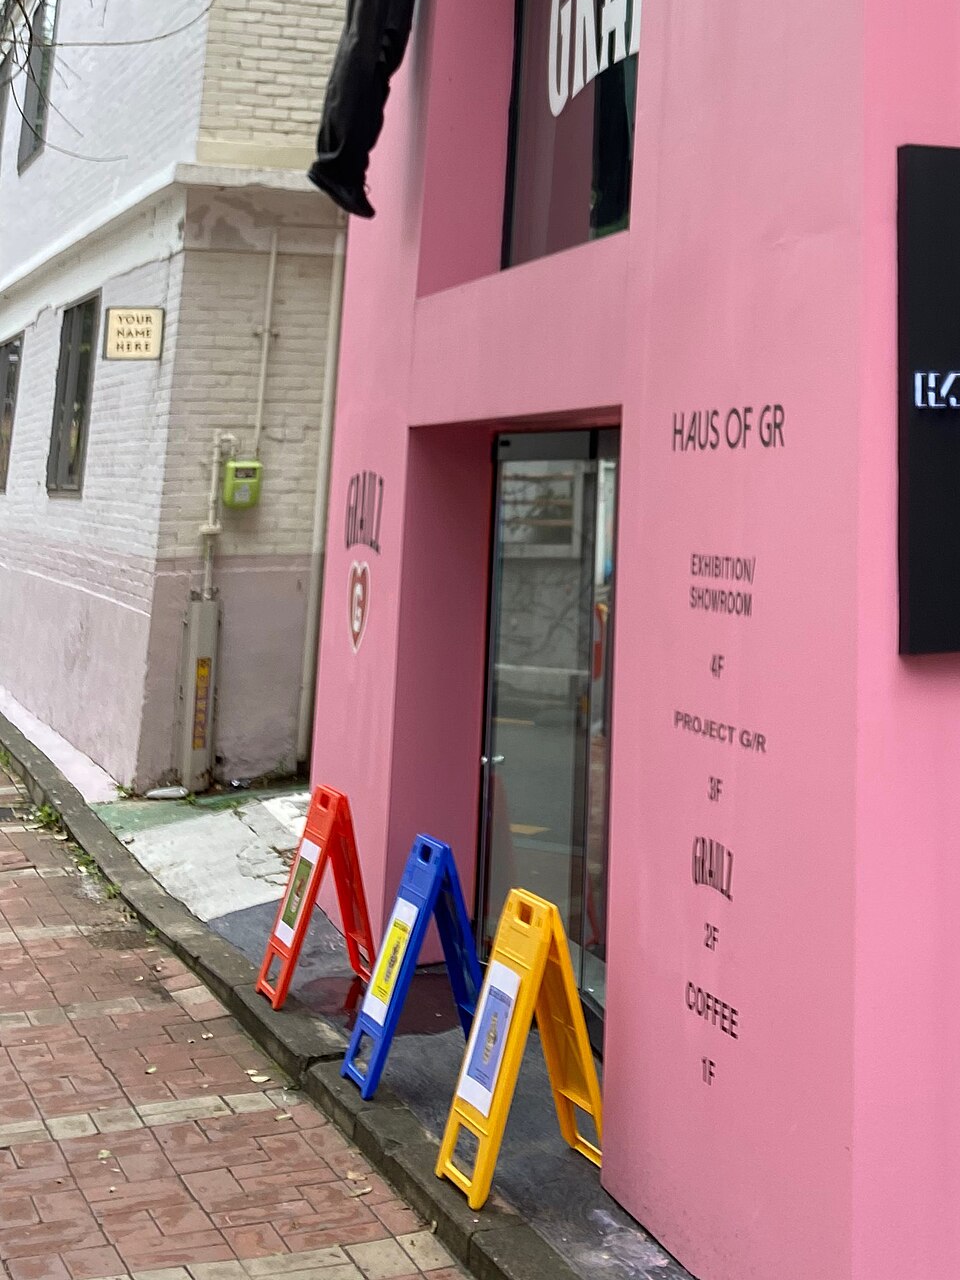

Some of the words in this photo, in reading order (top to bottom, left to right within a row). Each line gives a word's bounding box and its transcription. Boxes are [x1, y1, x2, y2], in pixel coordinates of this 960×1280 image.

[116, 314, 153, 325] YOUR
[116, 327, 152, 338] NAME
[116, 341, 151, 353] HERE
[672, 409, 720, 452] HAUS
[725, 406, 754, 449] OF
[759, 403, 785, 448] GR
[690, 553, 756, 585] EXHIBITION/
[689, 585, 752, 617] SHOWROOM
[710, 653, 725, 678] 4F
[673, 709, 737, 745] PROJECT
[738, 728, 767, 754] G/R
[707, 775, 723, 802] 3F
[703, 921, 719, 952] 2F
[685, 980, 739, 1040] COFFEE
[701, 1055, 716, 1086] 1F
